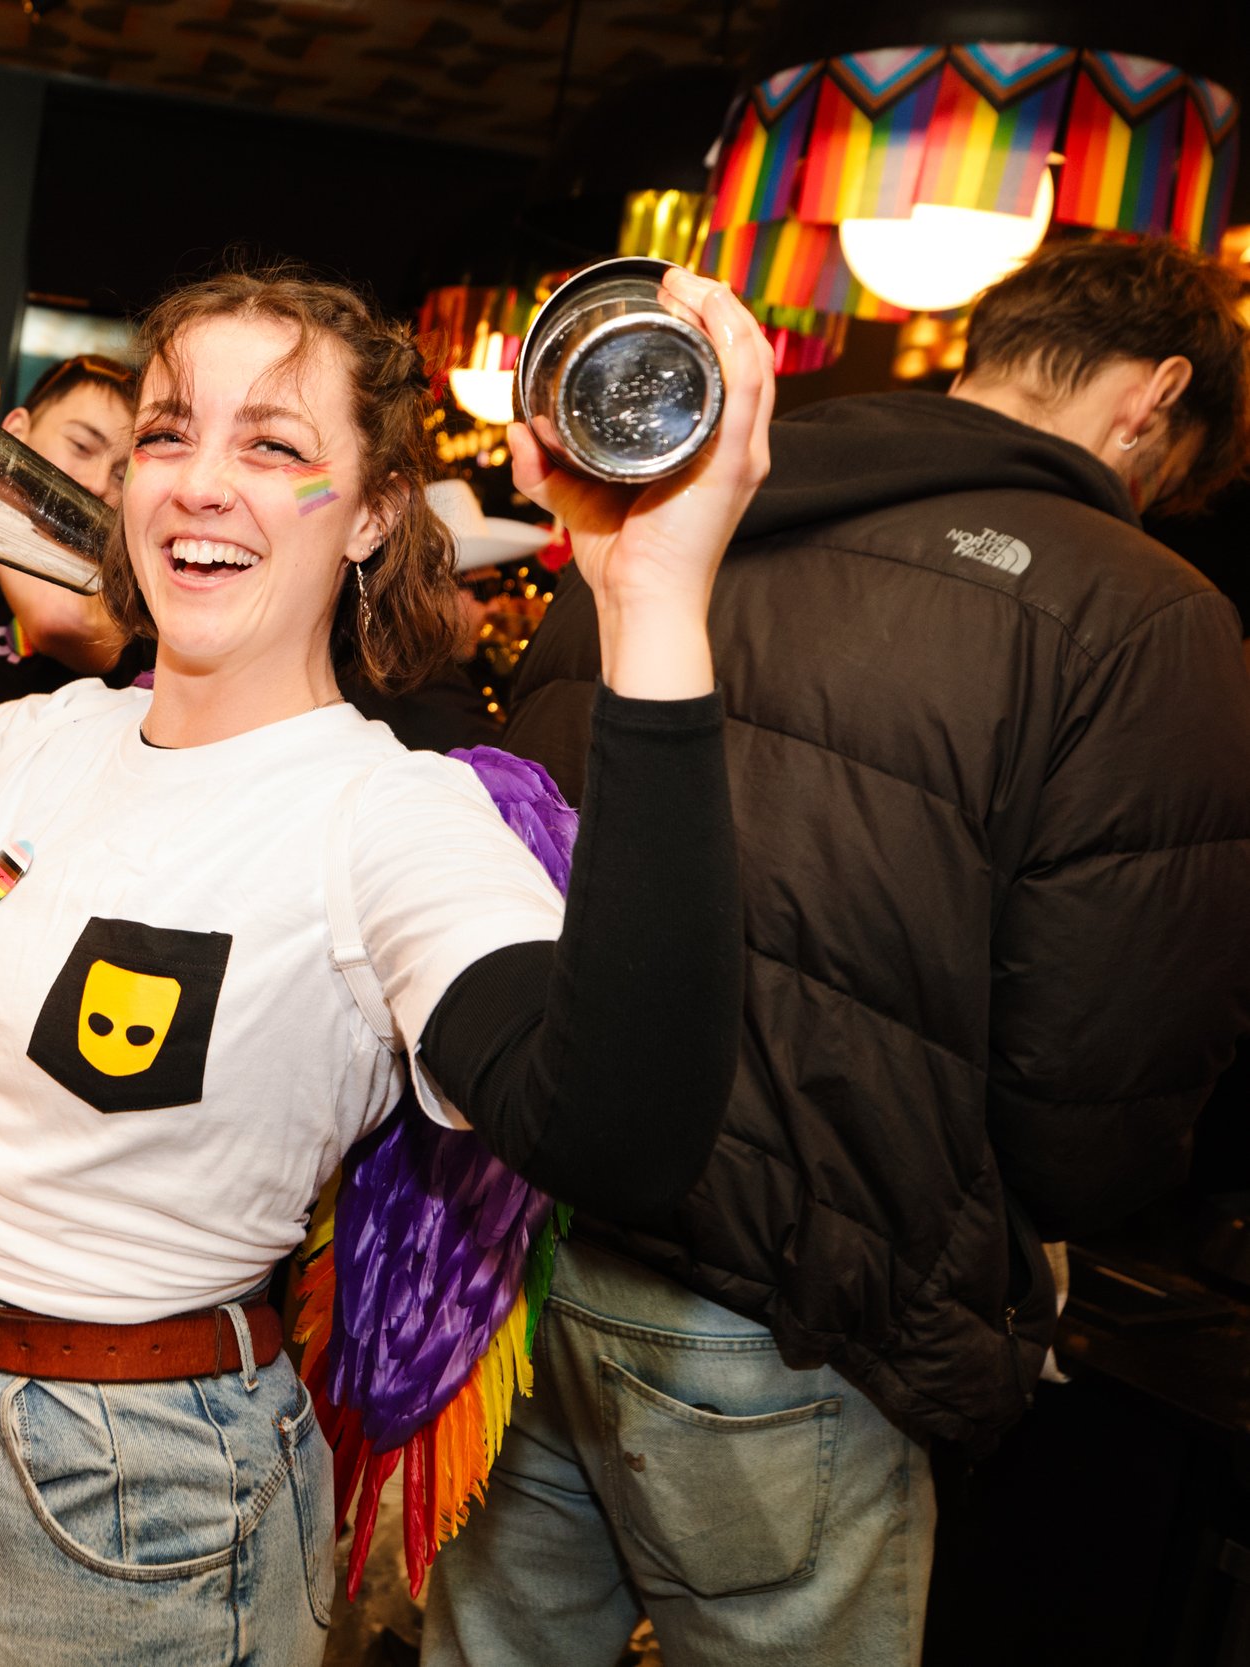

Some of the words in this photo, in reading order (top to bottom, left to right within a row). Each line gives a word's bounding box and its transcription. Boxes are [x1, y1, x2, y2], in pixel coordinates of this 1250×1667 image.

[945, 528, 1006, 556] NORTH
[981, 528, 1015, 543] THE
[953, 543, 996, 565] FACE
